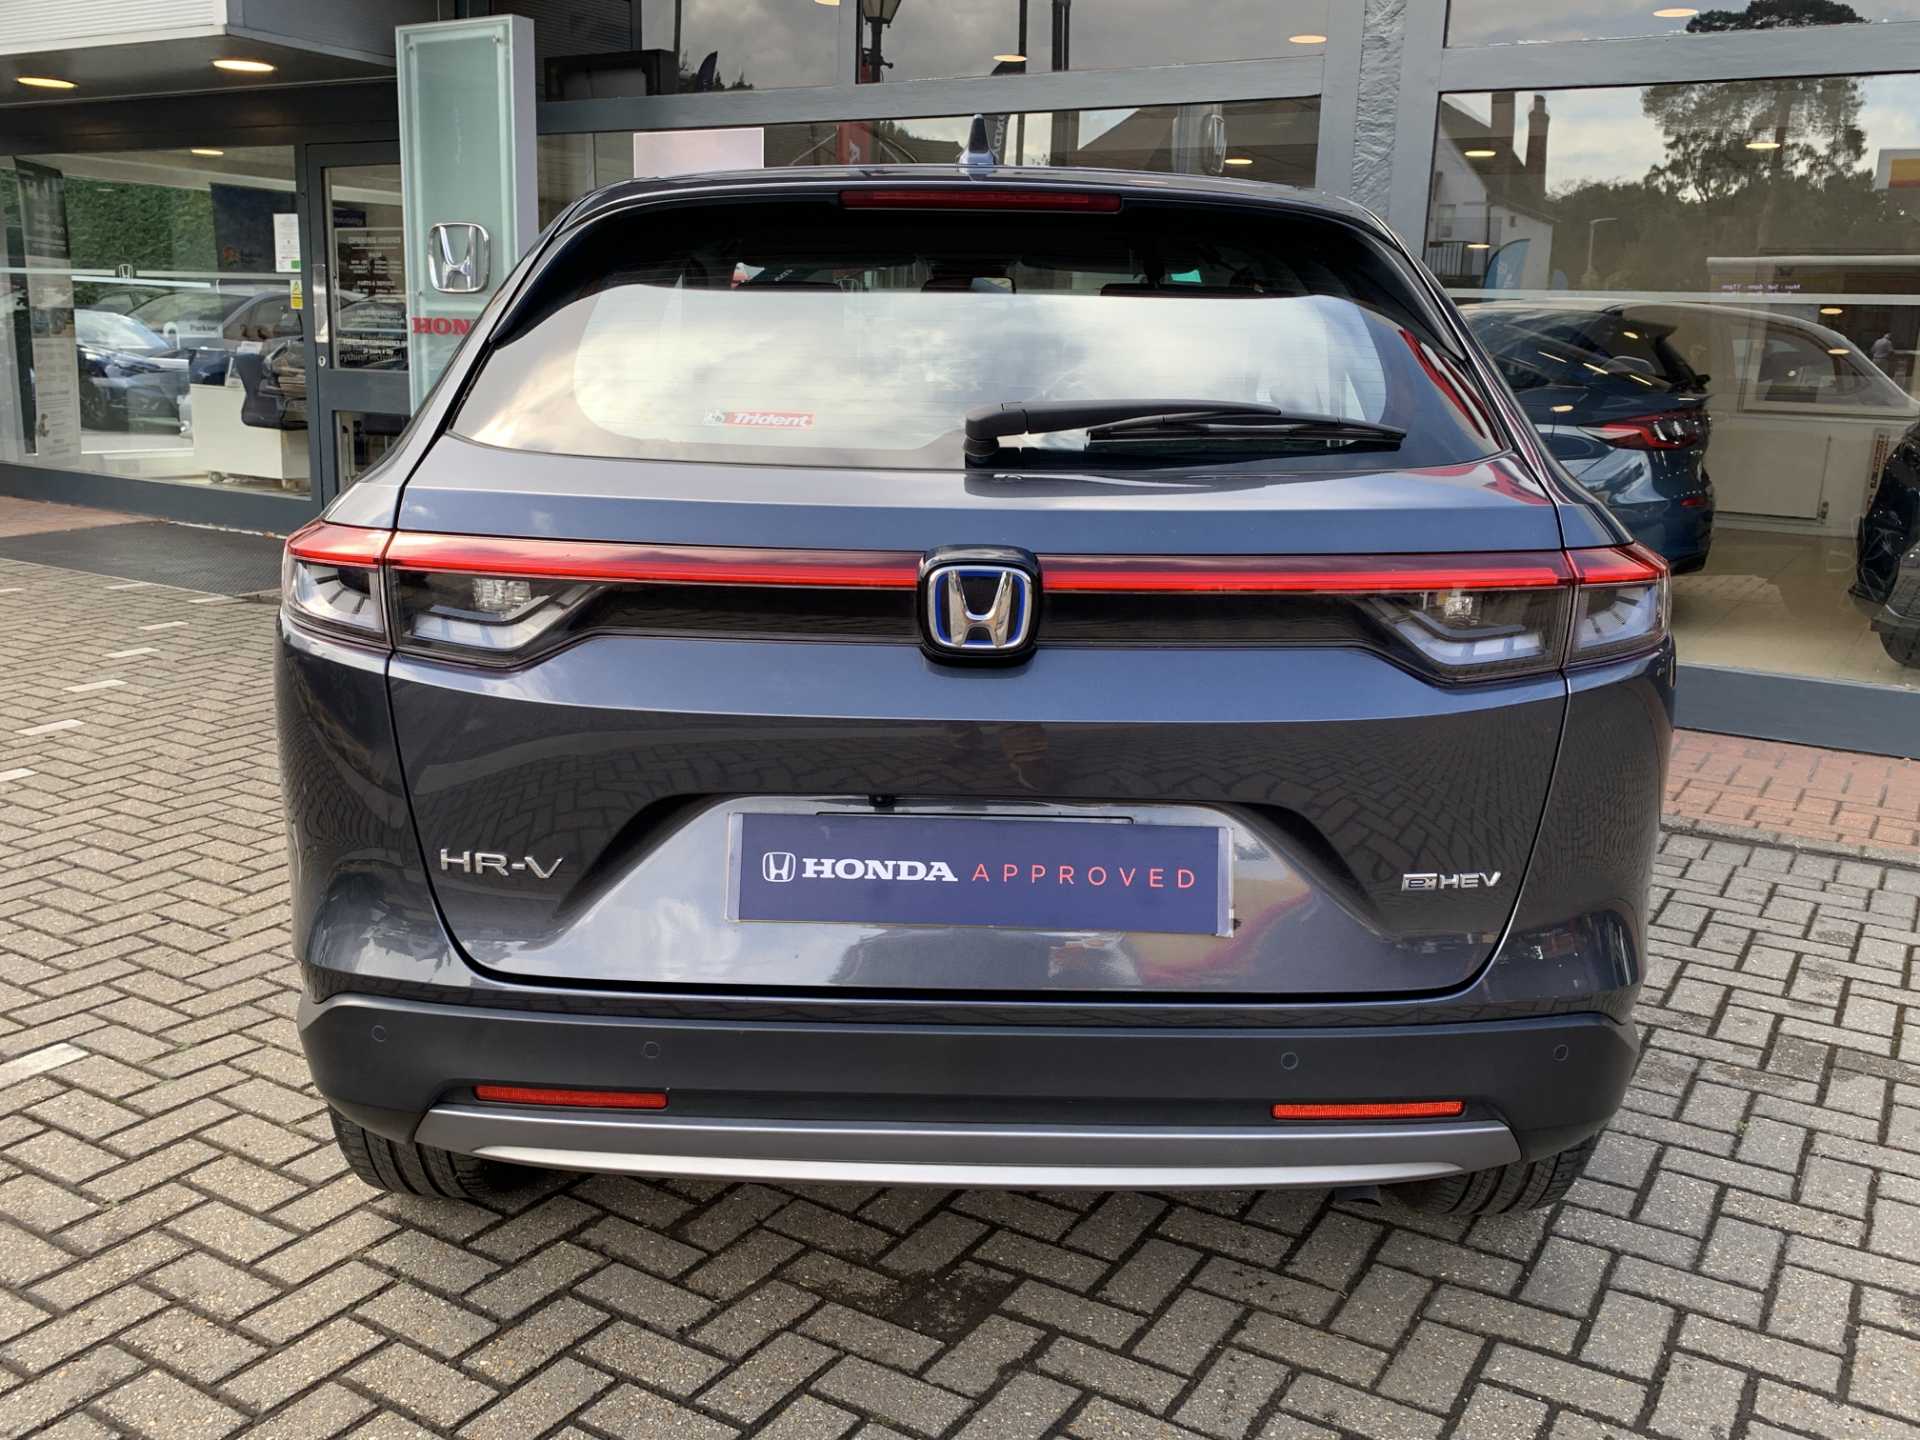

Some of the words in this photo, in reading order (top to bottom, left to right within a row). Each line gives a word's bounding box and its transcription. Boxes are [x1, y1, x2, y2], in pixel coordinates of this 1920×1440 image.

[412, 317, 473, 335] HON
[734, 412, 809, 427] Trident
[440, 848, 564, 879] HR-V
[802, 857, 959, 882] HONDA
[971, 863, 1196, 889] APPROVED
